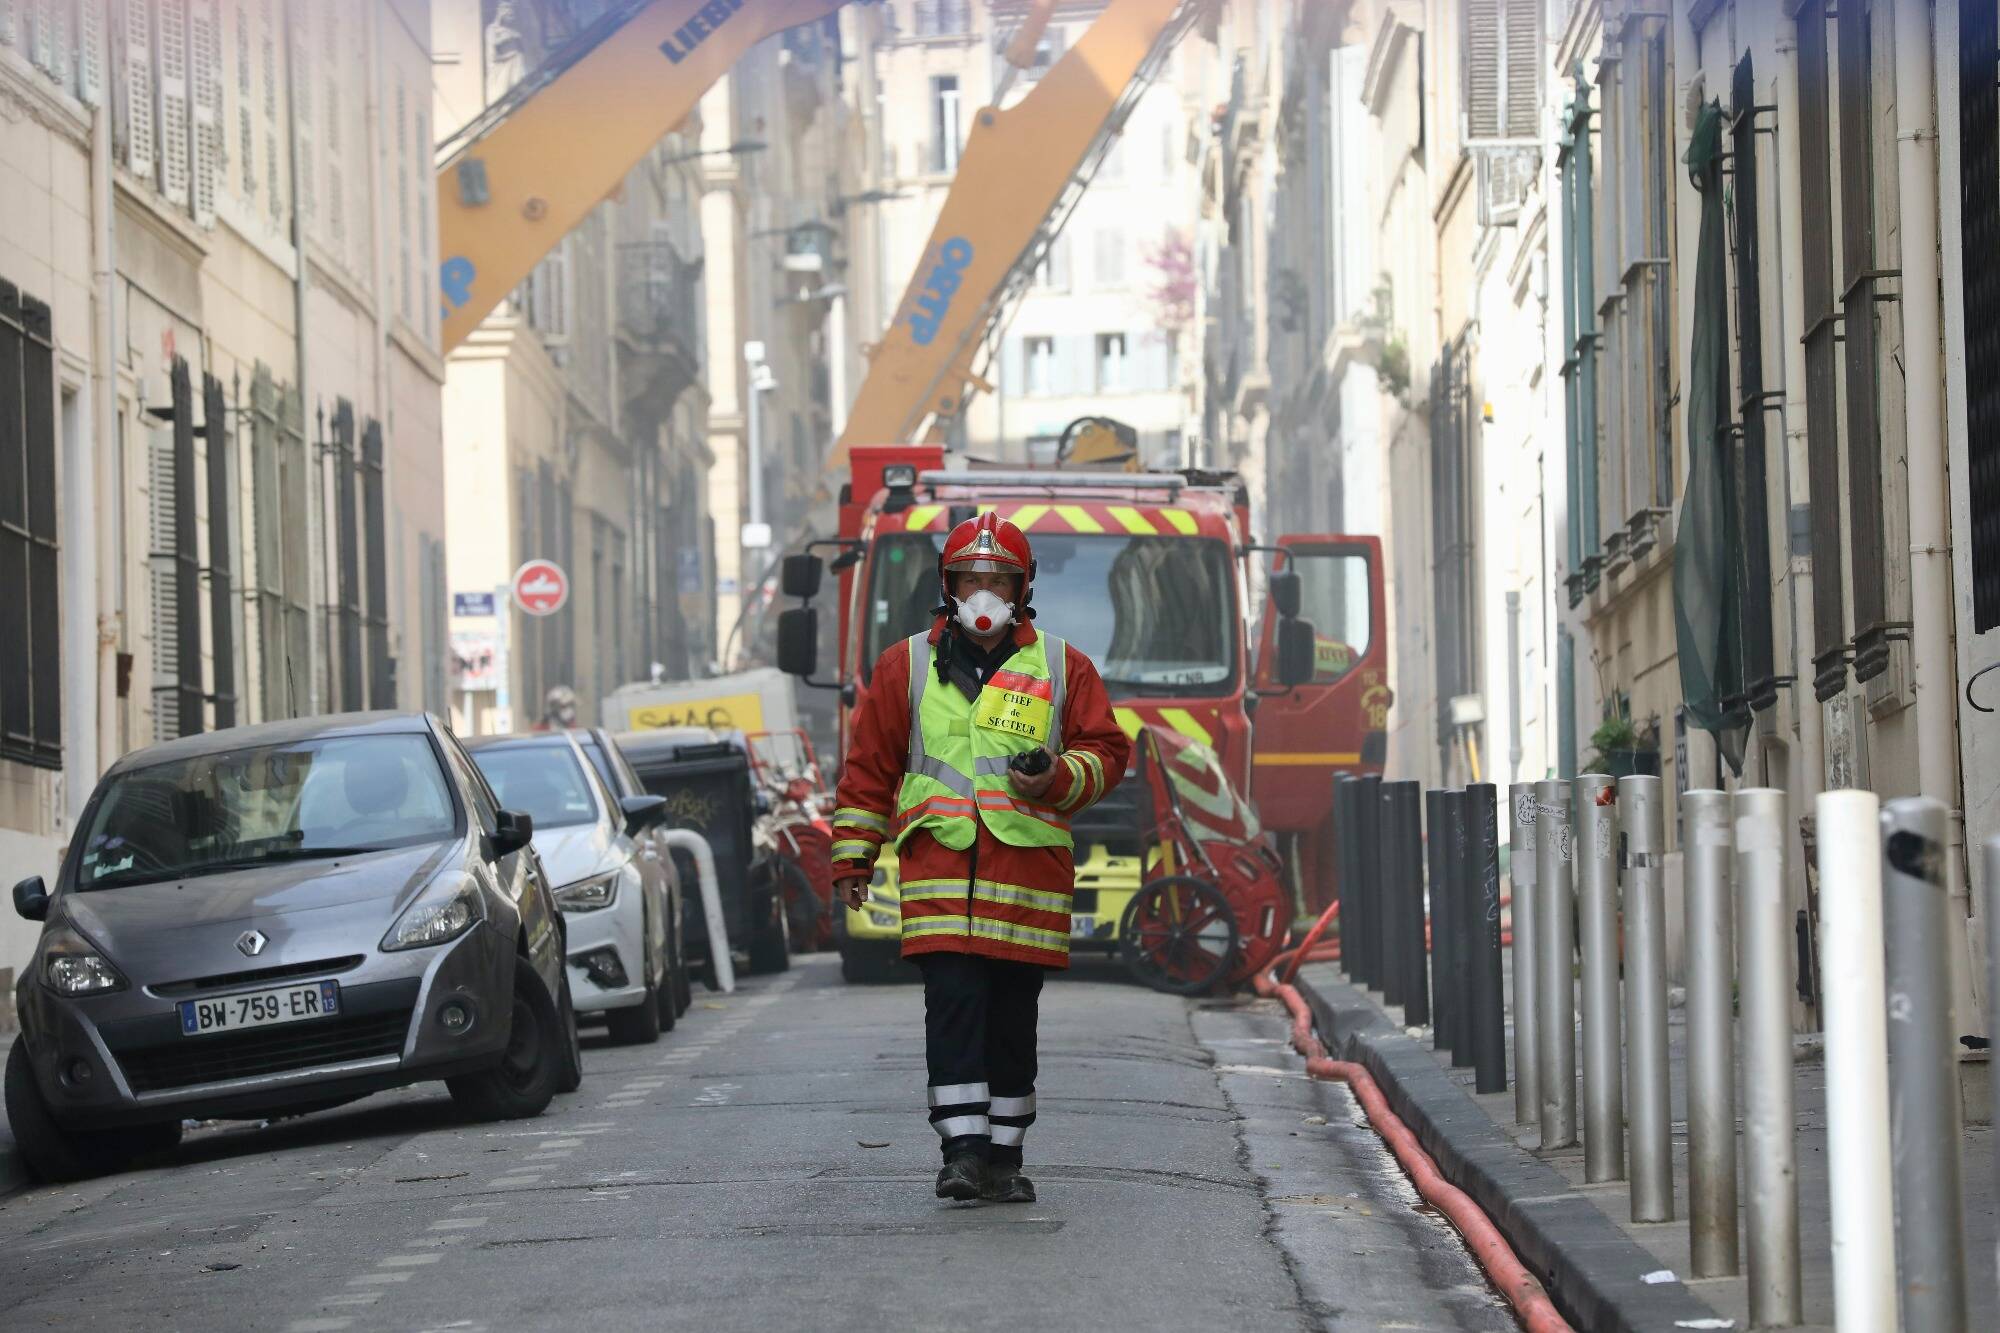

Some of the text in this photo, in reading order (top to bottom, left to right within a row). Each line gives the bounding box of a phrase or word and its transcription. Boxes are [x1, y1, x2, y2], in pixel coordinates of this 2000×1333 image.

[658, 0, 744, 64] LIEB
[1003, 693, 1032, 707] CHEF
[1010, 708, 1020, 717] de
[1367, 703, 1387, 728] 18
[987, 716, 1036, 735] SECTEUR
[199, 989, 318, 1029] BW-759-ER
[323, 998, 335, 1010] 13
